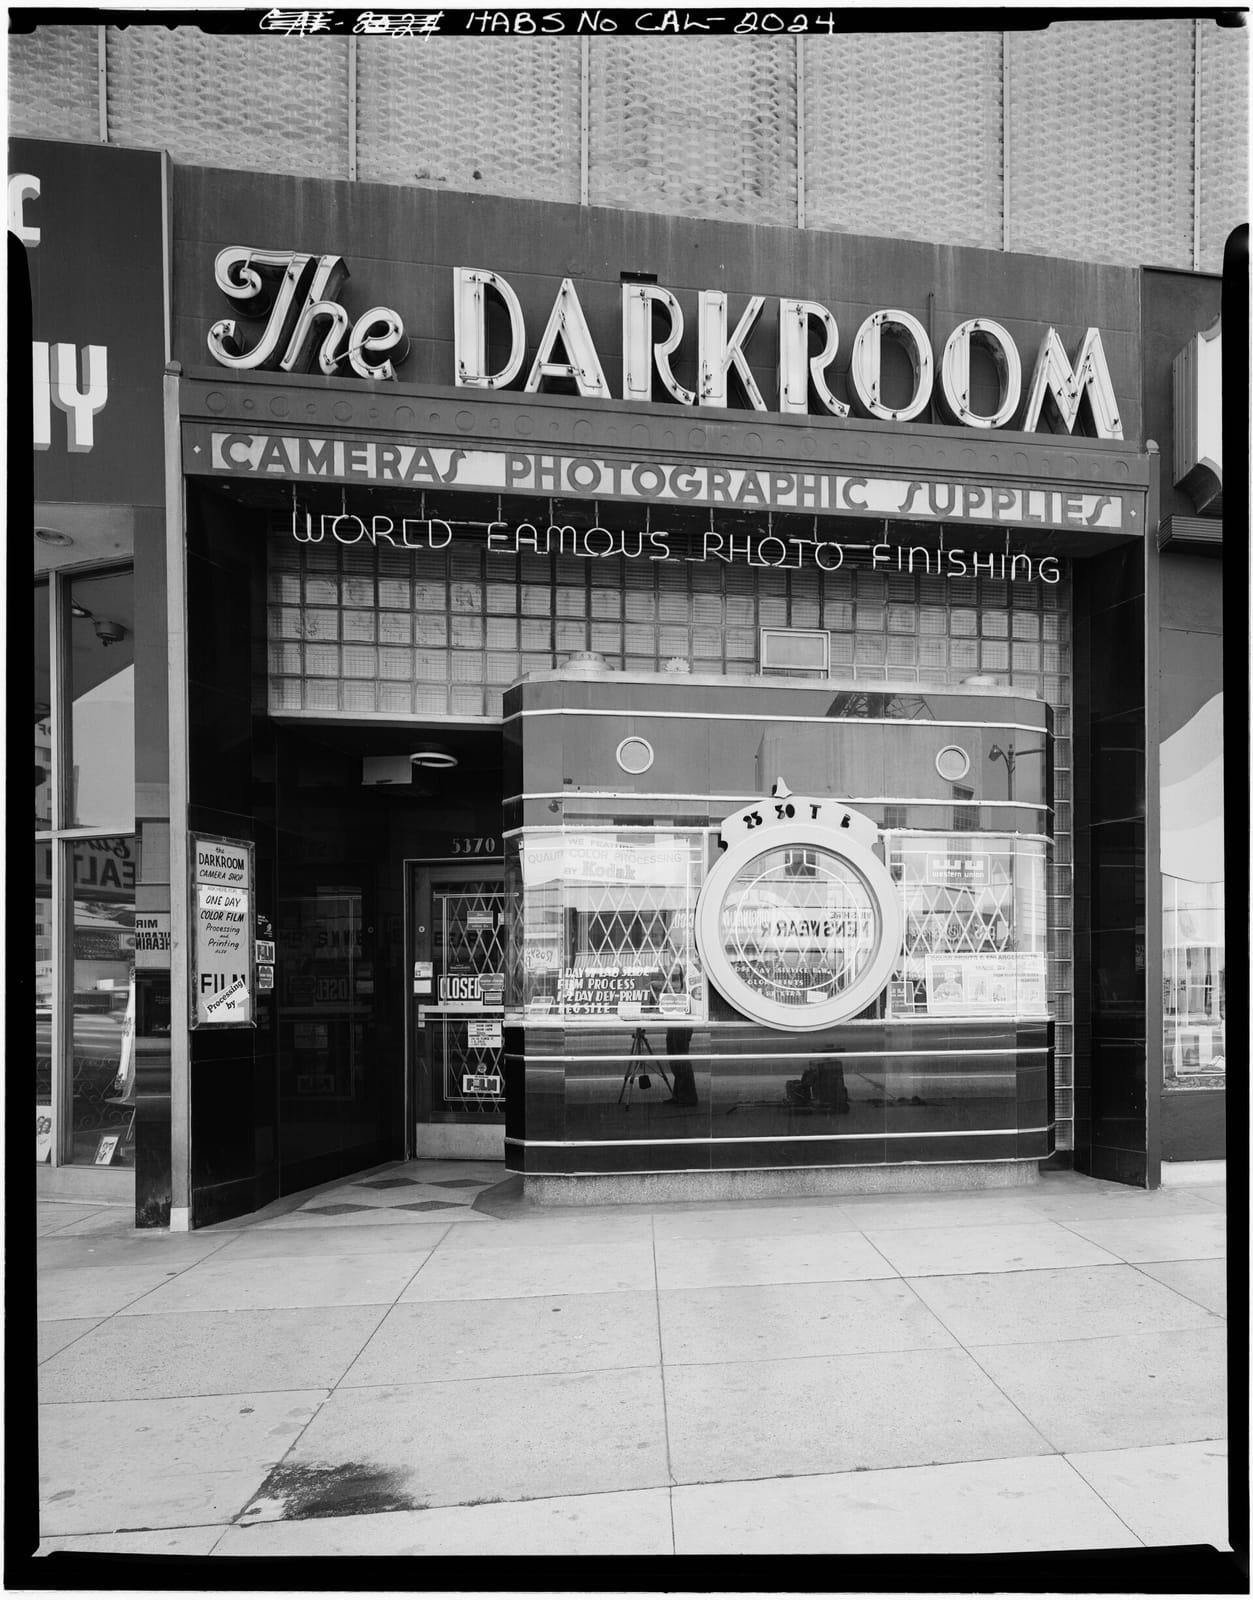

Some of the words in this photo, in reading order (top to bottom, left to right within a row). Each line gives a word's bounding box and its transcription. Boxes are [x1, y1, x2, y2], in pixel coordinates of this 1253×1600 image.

[207, 245, 411, 381] The
[453, 265, 1124, 441] DARKROOM
[220, 434, 467, 484] CAMERAS
[505, 453, 869, 511] PHOTOGRAPHIC
[897, 481, 1113, 526] SUPPLIES
[292, 510, 452, 549] WORLD
[487, 521, 670, 560] FAMOUS
[703, 531, 844, 571] PHOTO
[872, 543, 1061, 584] FINISHING
[809, 804, 822, 819] T
[451, 837, 495, 854] 5370
[198, 852, 245, 871] DARKROOM
[199, 869, 226, 880] CAMERA
[227, 872, 244, 882] SHOP
[205, 894, 223, 906] ONE
[224, 896, 242, 908] DAY
[200, 910, 224, 921] COLOR
[226, 912, 245, 923] FILM
[205, 922, 241, 936] Processing
[207, 937, 241, 951] Printing
[565, 966, 585, 978] DAY
[439, 977, 481, 1000] CLOSED
[587, 978, 636, 991] PROCESS
[206, 980, 244, 1014] Processing
[573, 990, 594, 1002] DAY
[595, 989, 650, 1002] DEV-PRINT
[225, 999, 236, 1010] by
